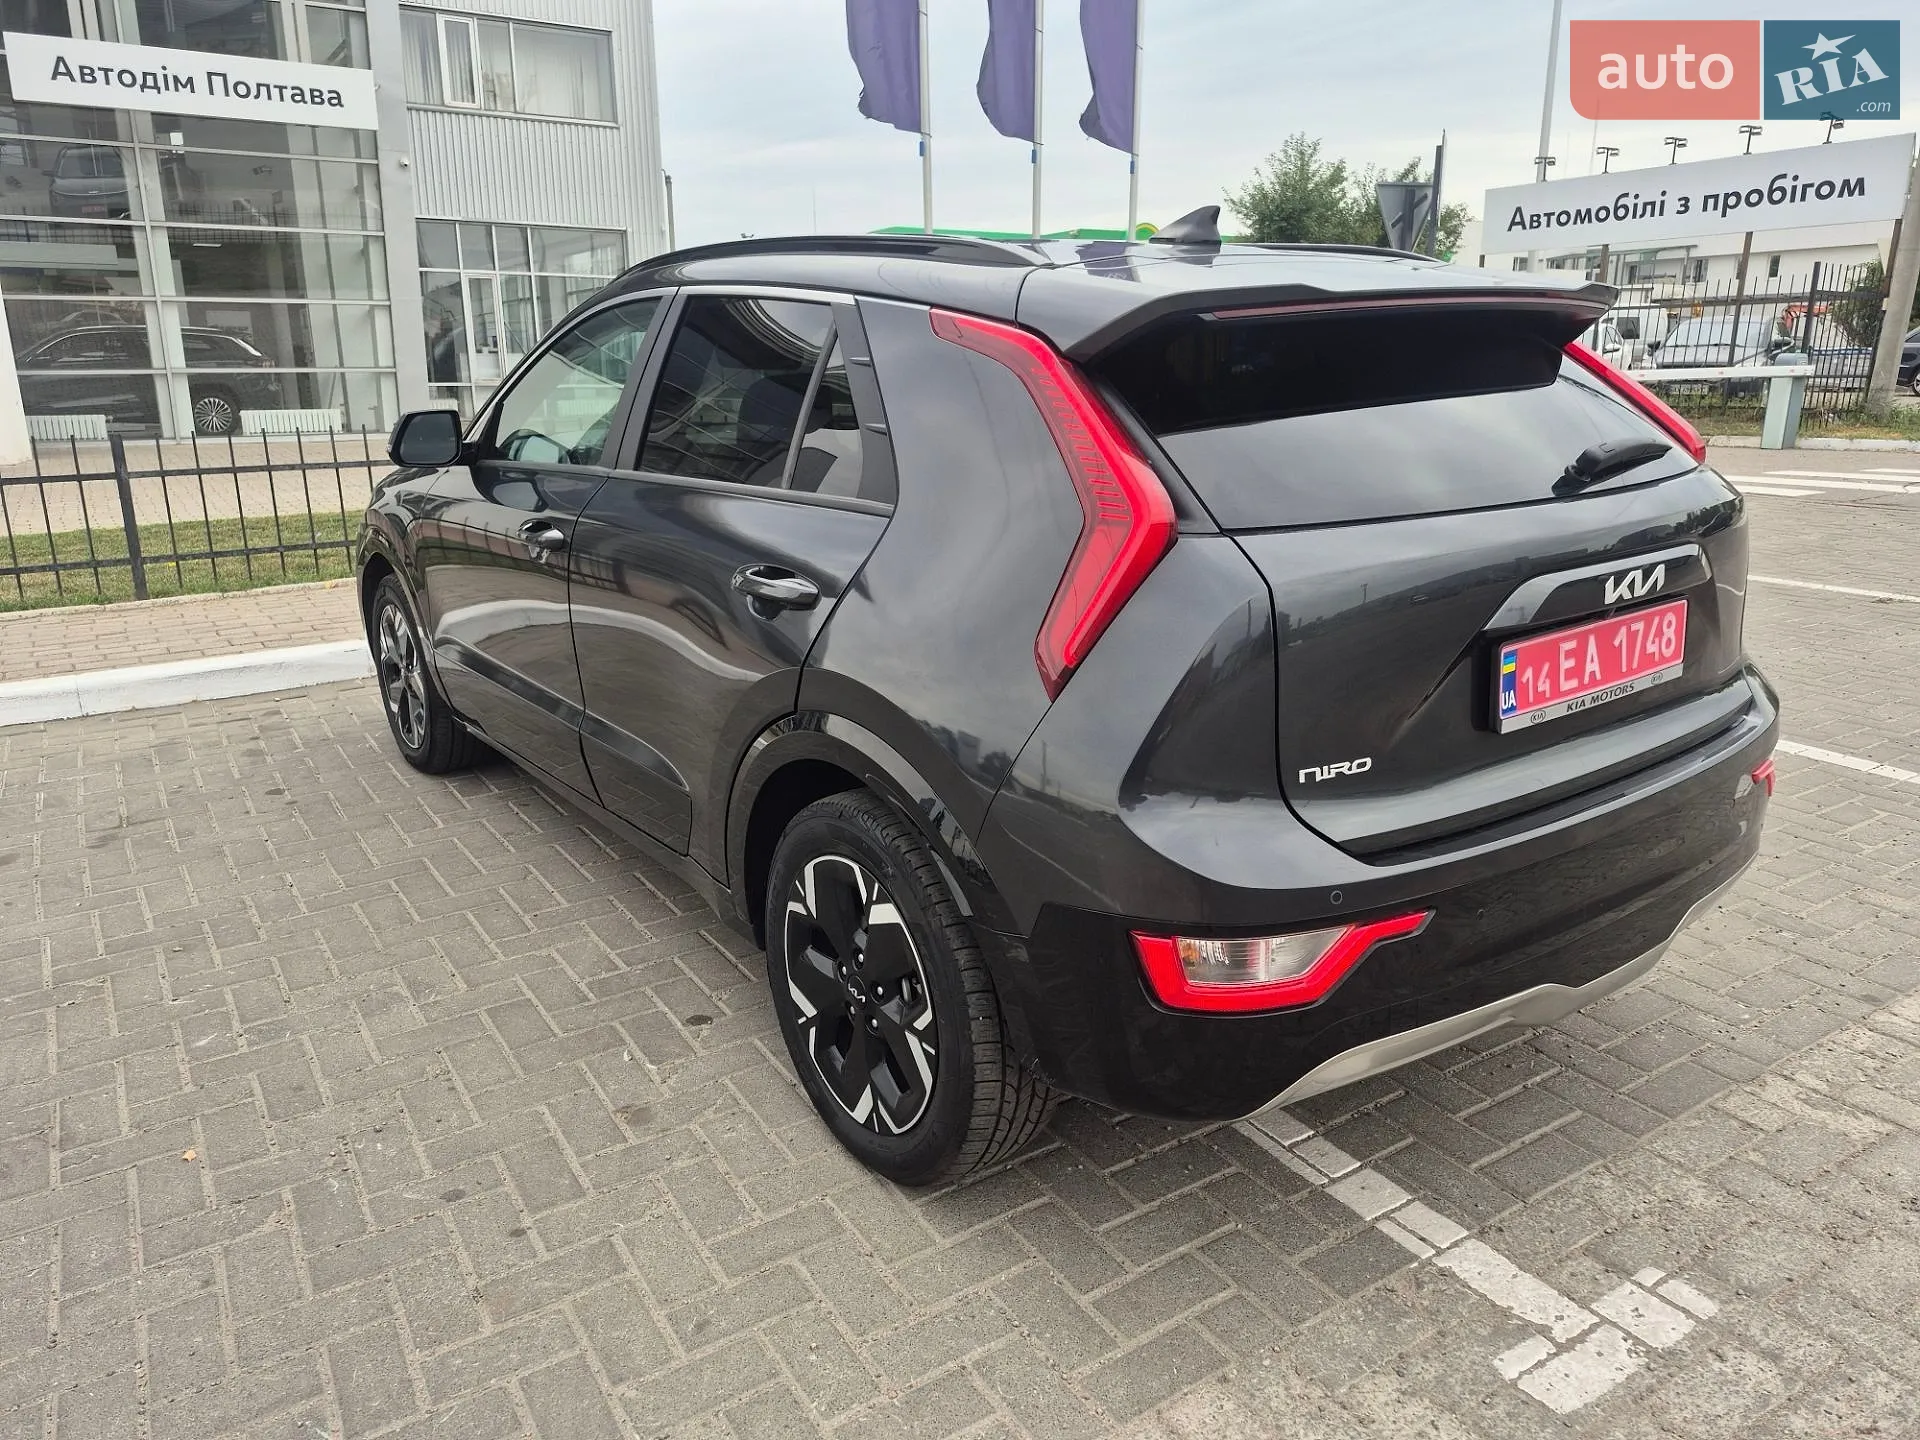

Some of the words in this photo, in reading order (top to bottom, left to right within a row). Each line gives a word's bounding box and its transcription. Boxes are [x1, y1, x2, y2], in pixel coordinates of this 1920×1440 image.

[51, 56, 195, 94] Автодім
[206, 72, 344, 108] Полтава
[1507, 190, 1667, 232] Автомобілі
[1675, 196, 1690, 216] з
[1701, 173, 1866, 218] пробігом
[1605, 564, 1665, 605] KIA
[1521, 662, 1550, 704] 14
[1560, 635, 1601, 691] EA
[1613, 612, 1676, 673] 1748
[1502, 690, 1516, 709] UA
[1566, 700, 1586, 712] KIA
[1590, 683, 1634, 703] MOTORS
